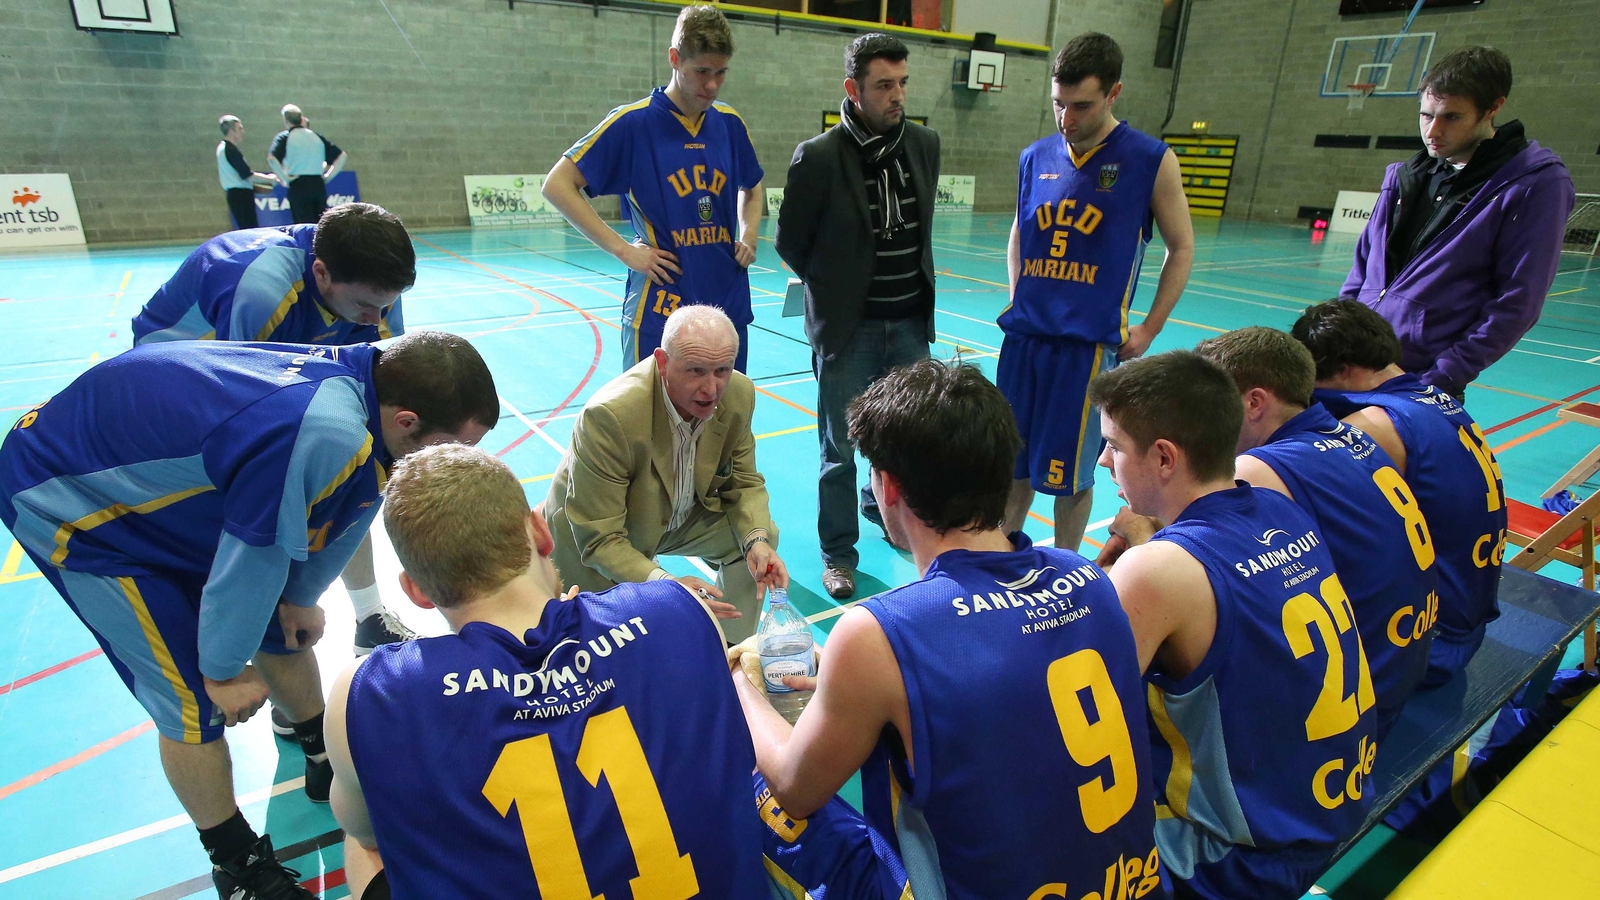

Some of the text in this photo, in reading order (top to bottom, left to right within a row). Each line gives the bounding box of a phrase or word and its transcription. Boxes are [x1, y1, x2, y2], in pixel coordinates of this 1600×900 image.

[667, 165, 727, 197] UCD
[28, 207, 59, 222] tsb
[1036, 199, 1103, 235] UCD
[1342, 208, 1370, 219] Title
[1050, 230, 1069, 257] 5
[1023, 259, 1098, 284] MARIAN
[653, 289, 681, 317] 13
[1048, 459, 1064, 485] 5
[1372, 466, 1435, 571] 8
[1022, 605, 1091, 635] AT AVIVA STADIUM
[1025, 597, 1074, 620] HOTEL
[442, 616, 649, 698] SANDYMOUNT
[513, 678, 616, 721] AT AVIVA STADIUM
[1046, 648, 1139, 834] 9
[481, 705, 700, 900] 11
